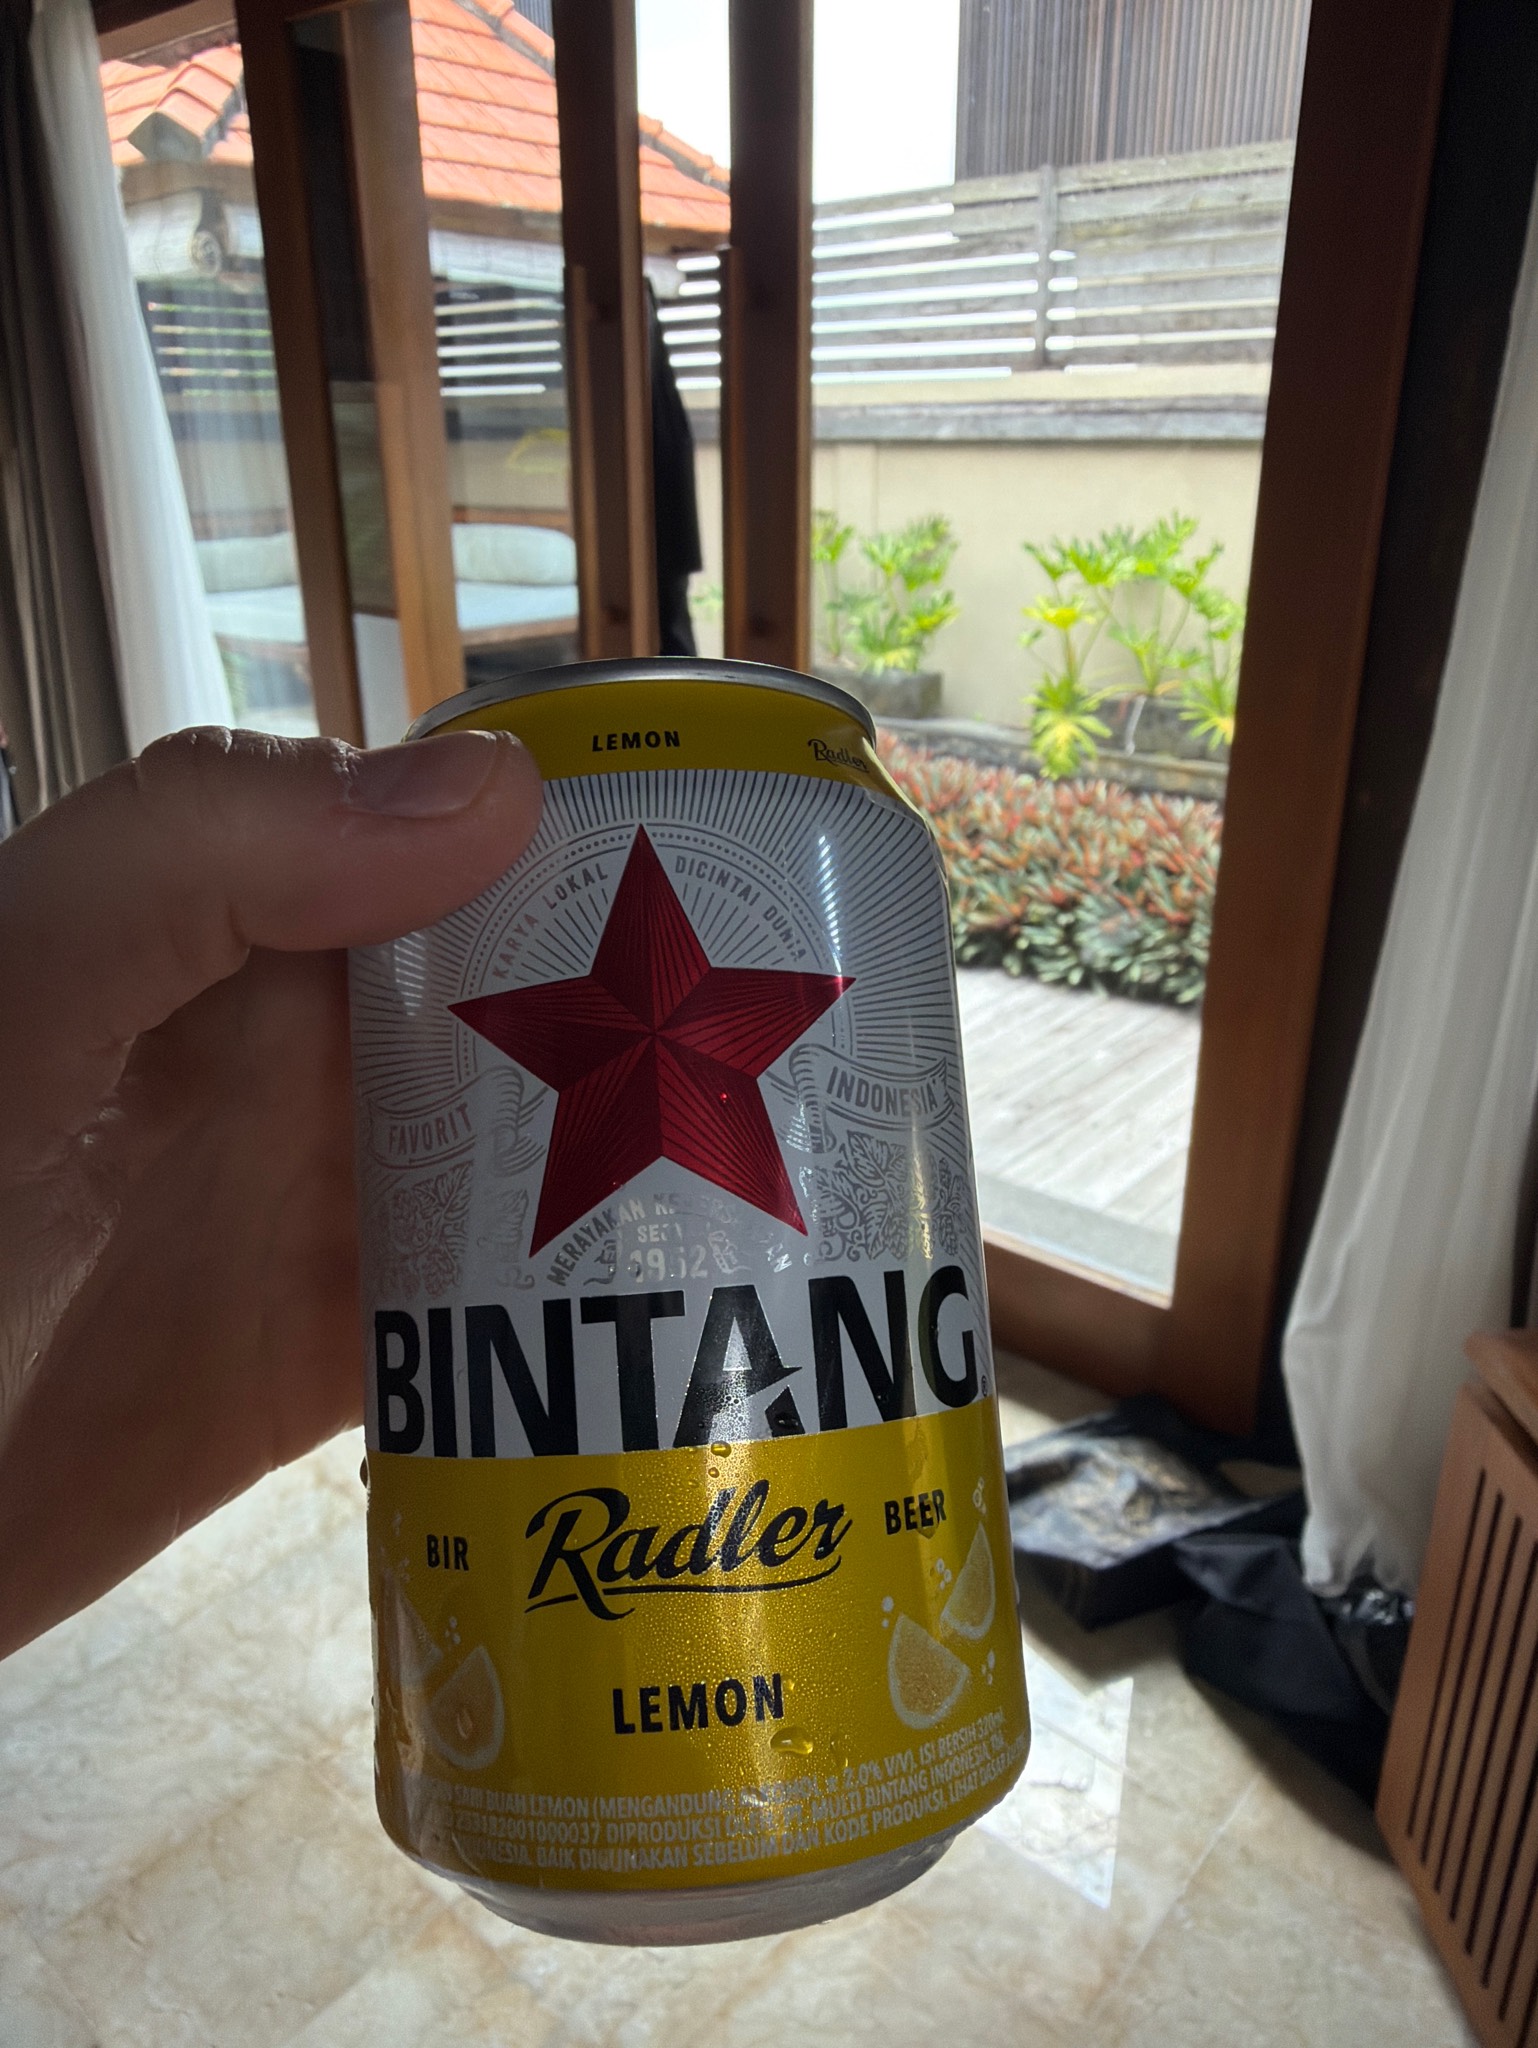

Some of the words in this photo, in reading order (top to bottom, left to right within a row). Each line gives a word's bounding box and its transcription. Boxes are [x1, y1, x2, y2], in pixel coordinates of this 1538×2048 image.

[592, 730, 681, 753] LEMON
[807, 738, 870, 773] Radler
[492, 912, 539, 980] KARYA
[546, 862, 608, 911] LOKAL
[675, 855, 762, 908] DICINTAI
[763, 904, 808, 963] DUNIA
[826, 1065, 939, 1118] INDONESIA
[388, 1102, 473, 1155] FAVORIT
[547, 1199, 646, 1287] MERAYAKAN
[375, 1265, 978, 1459] BINTANG
[884, 1488, 947, 1537] BEER
[426, 1533, 470, 1572] BIR
[524, 1479, 853, 1621] Radler
[612, 1672, 785, 1735] LEMON
[530, 1794, 588, 1818] LEMON
[606, 1814, 721, 1844] DIPRODUKSI
[865, 1769, 928, 1809] BINTANG
